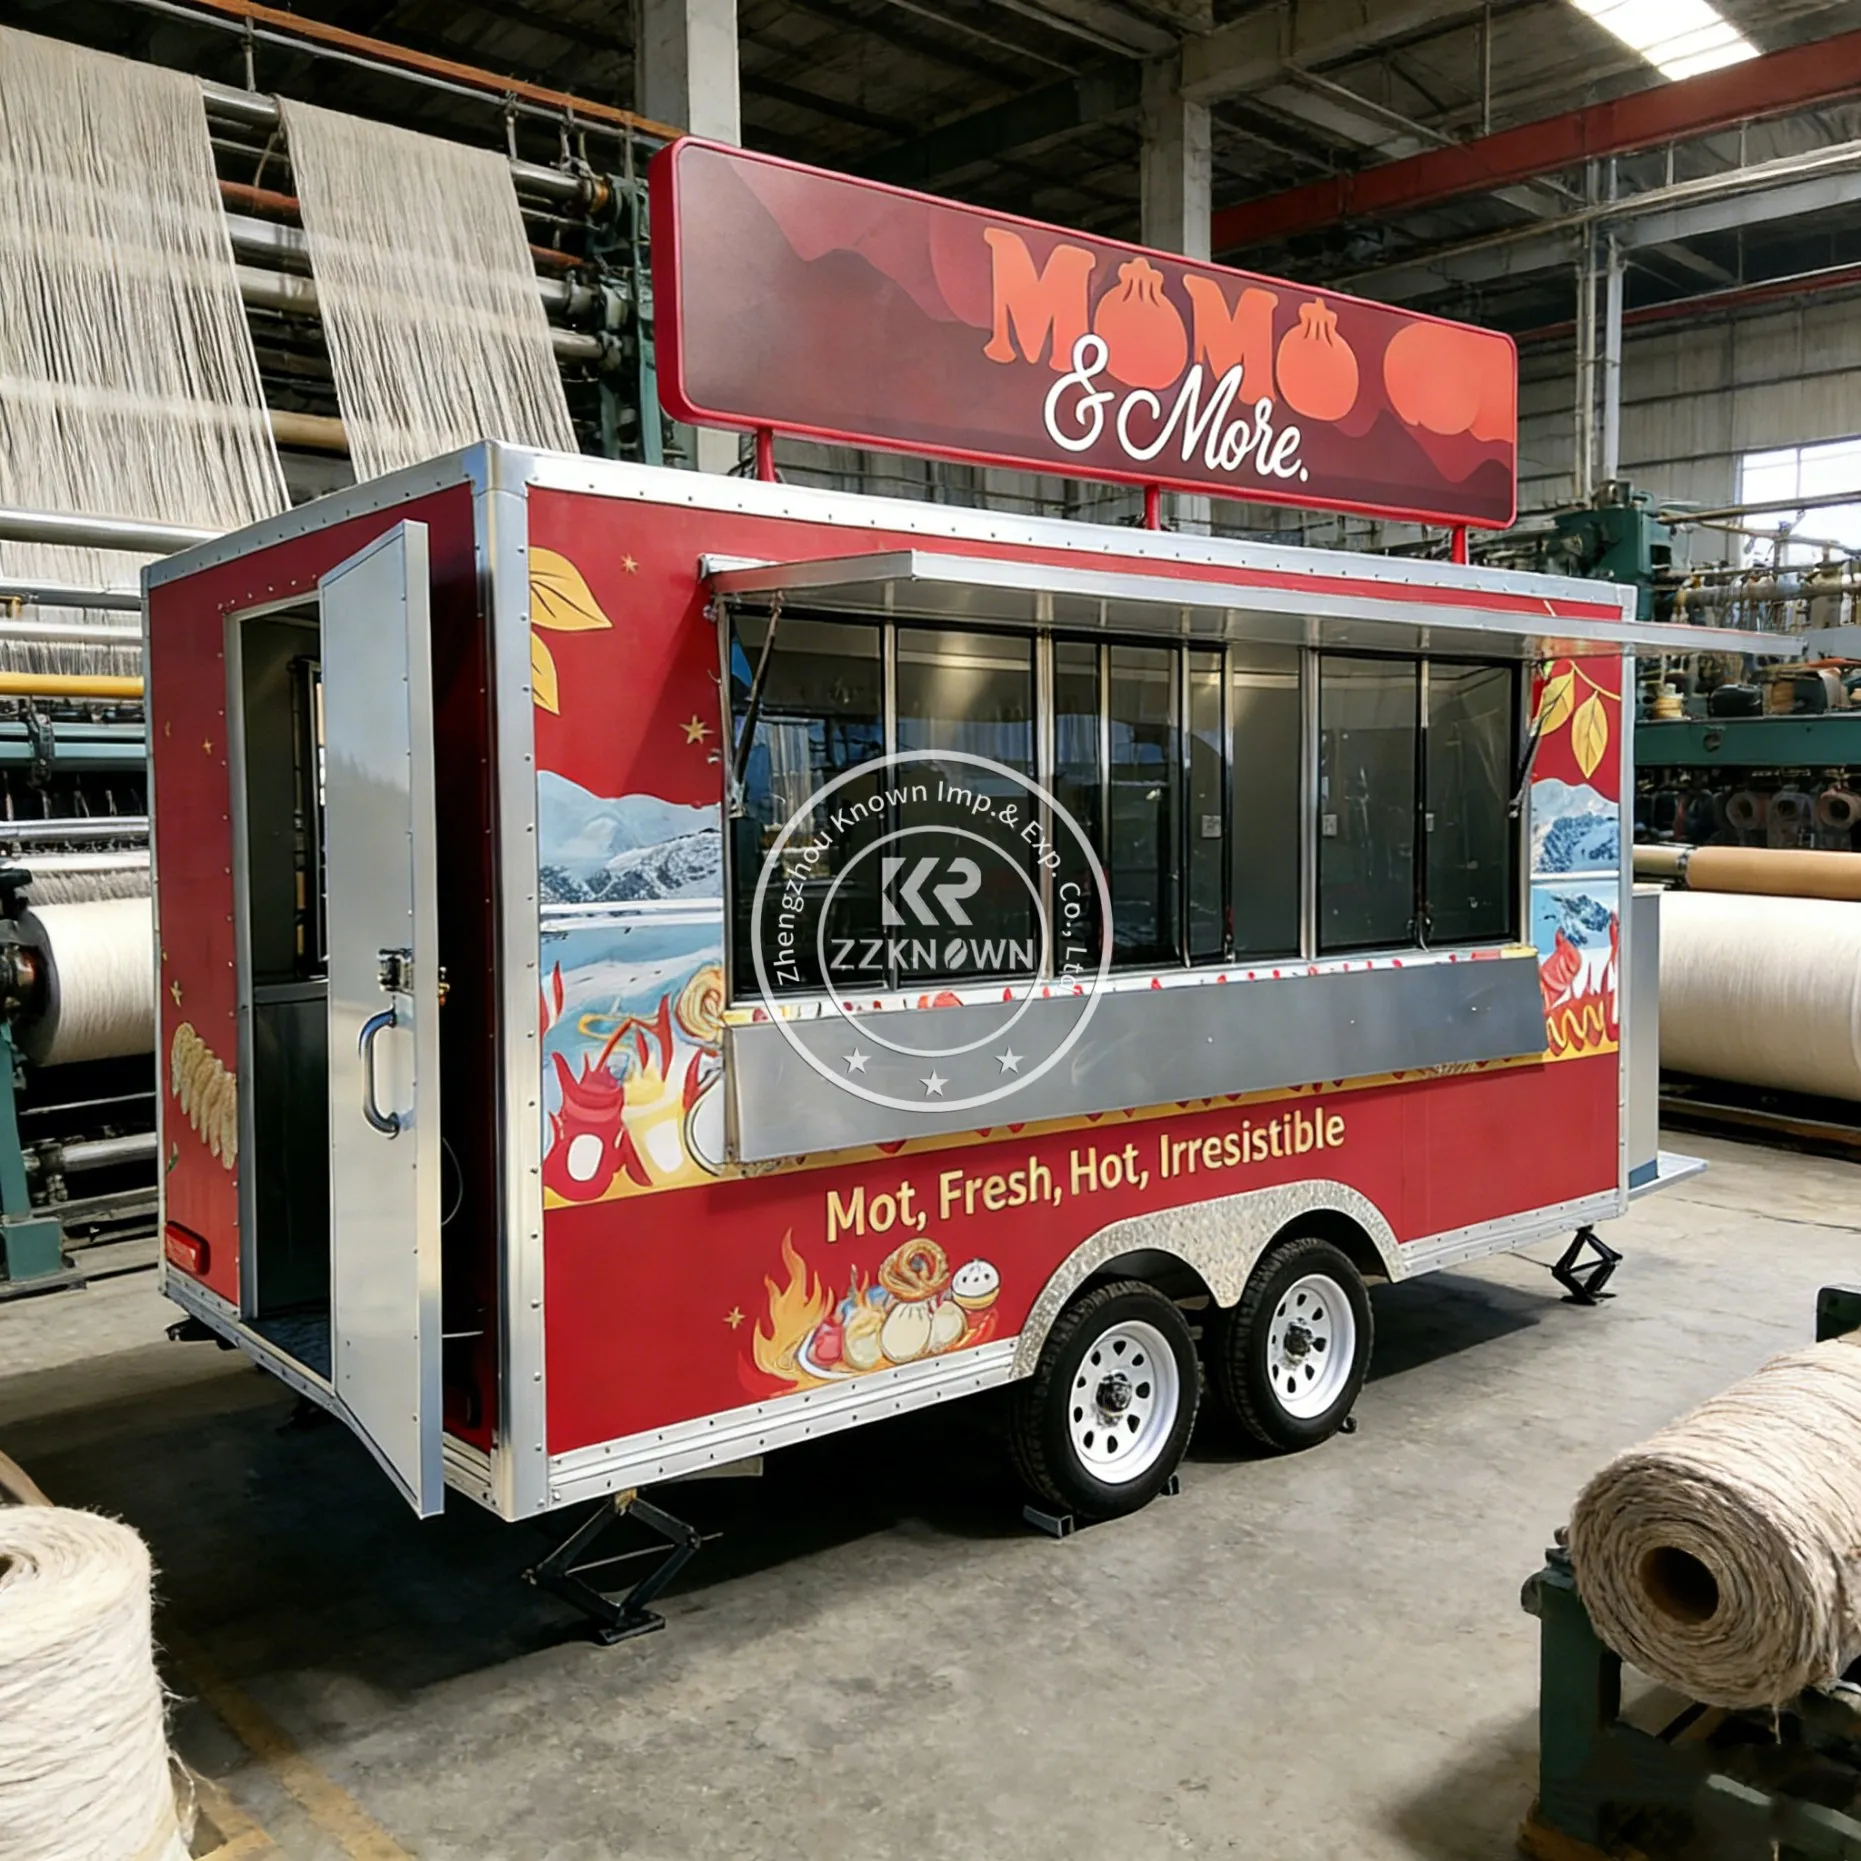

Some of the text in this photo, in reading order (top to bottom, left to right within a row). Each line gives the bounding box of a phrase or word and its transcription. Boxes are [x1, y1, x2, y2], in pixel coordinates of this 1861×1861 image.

[1044, 334, 1309, 482] & More.
[826, 1106, 1345, 1242] Mot, Fresh, Hot, Irresistible
